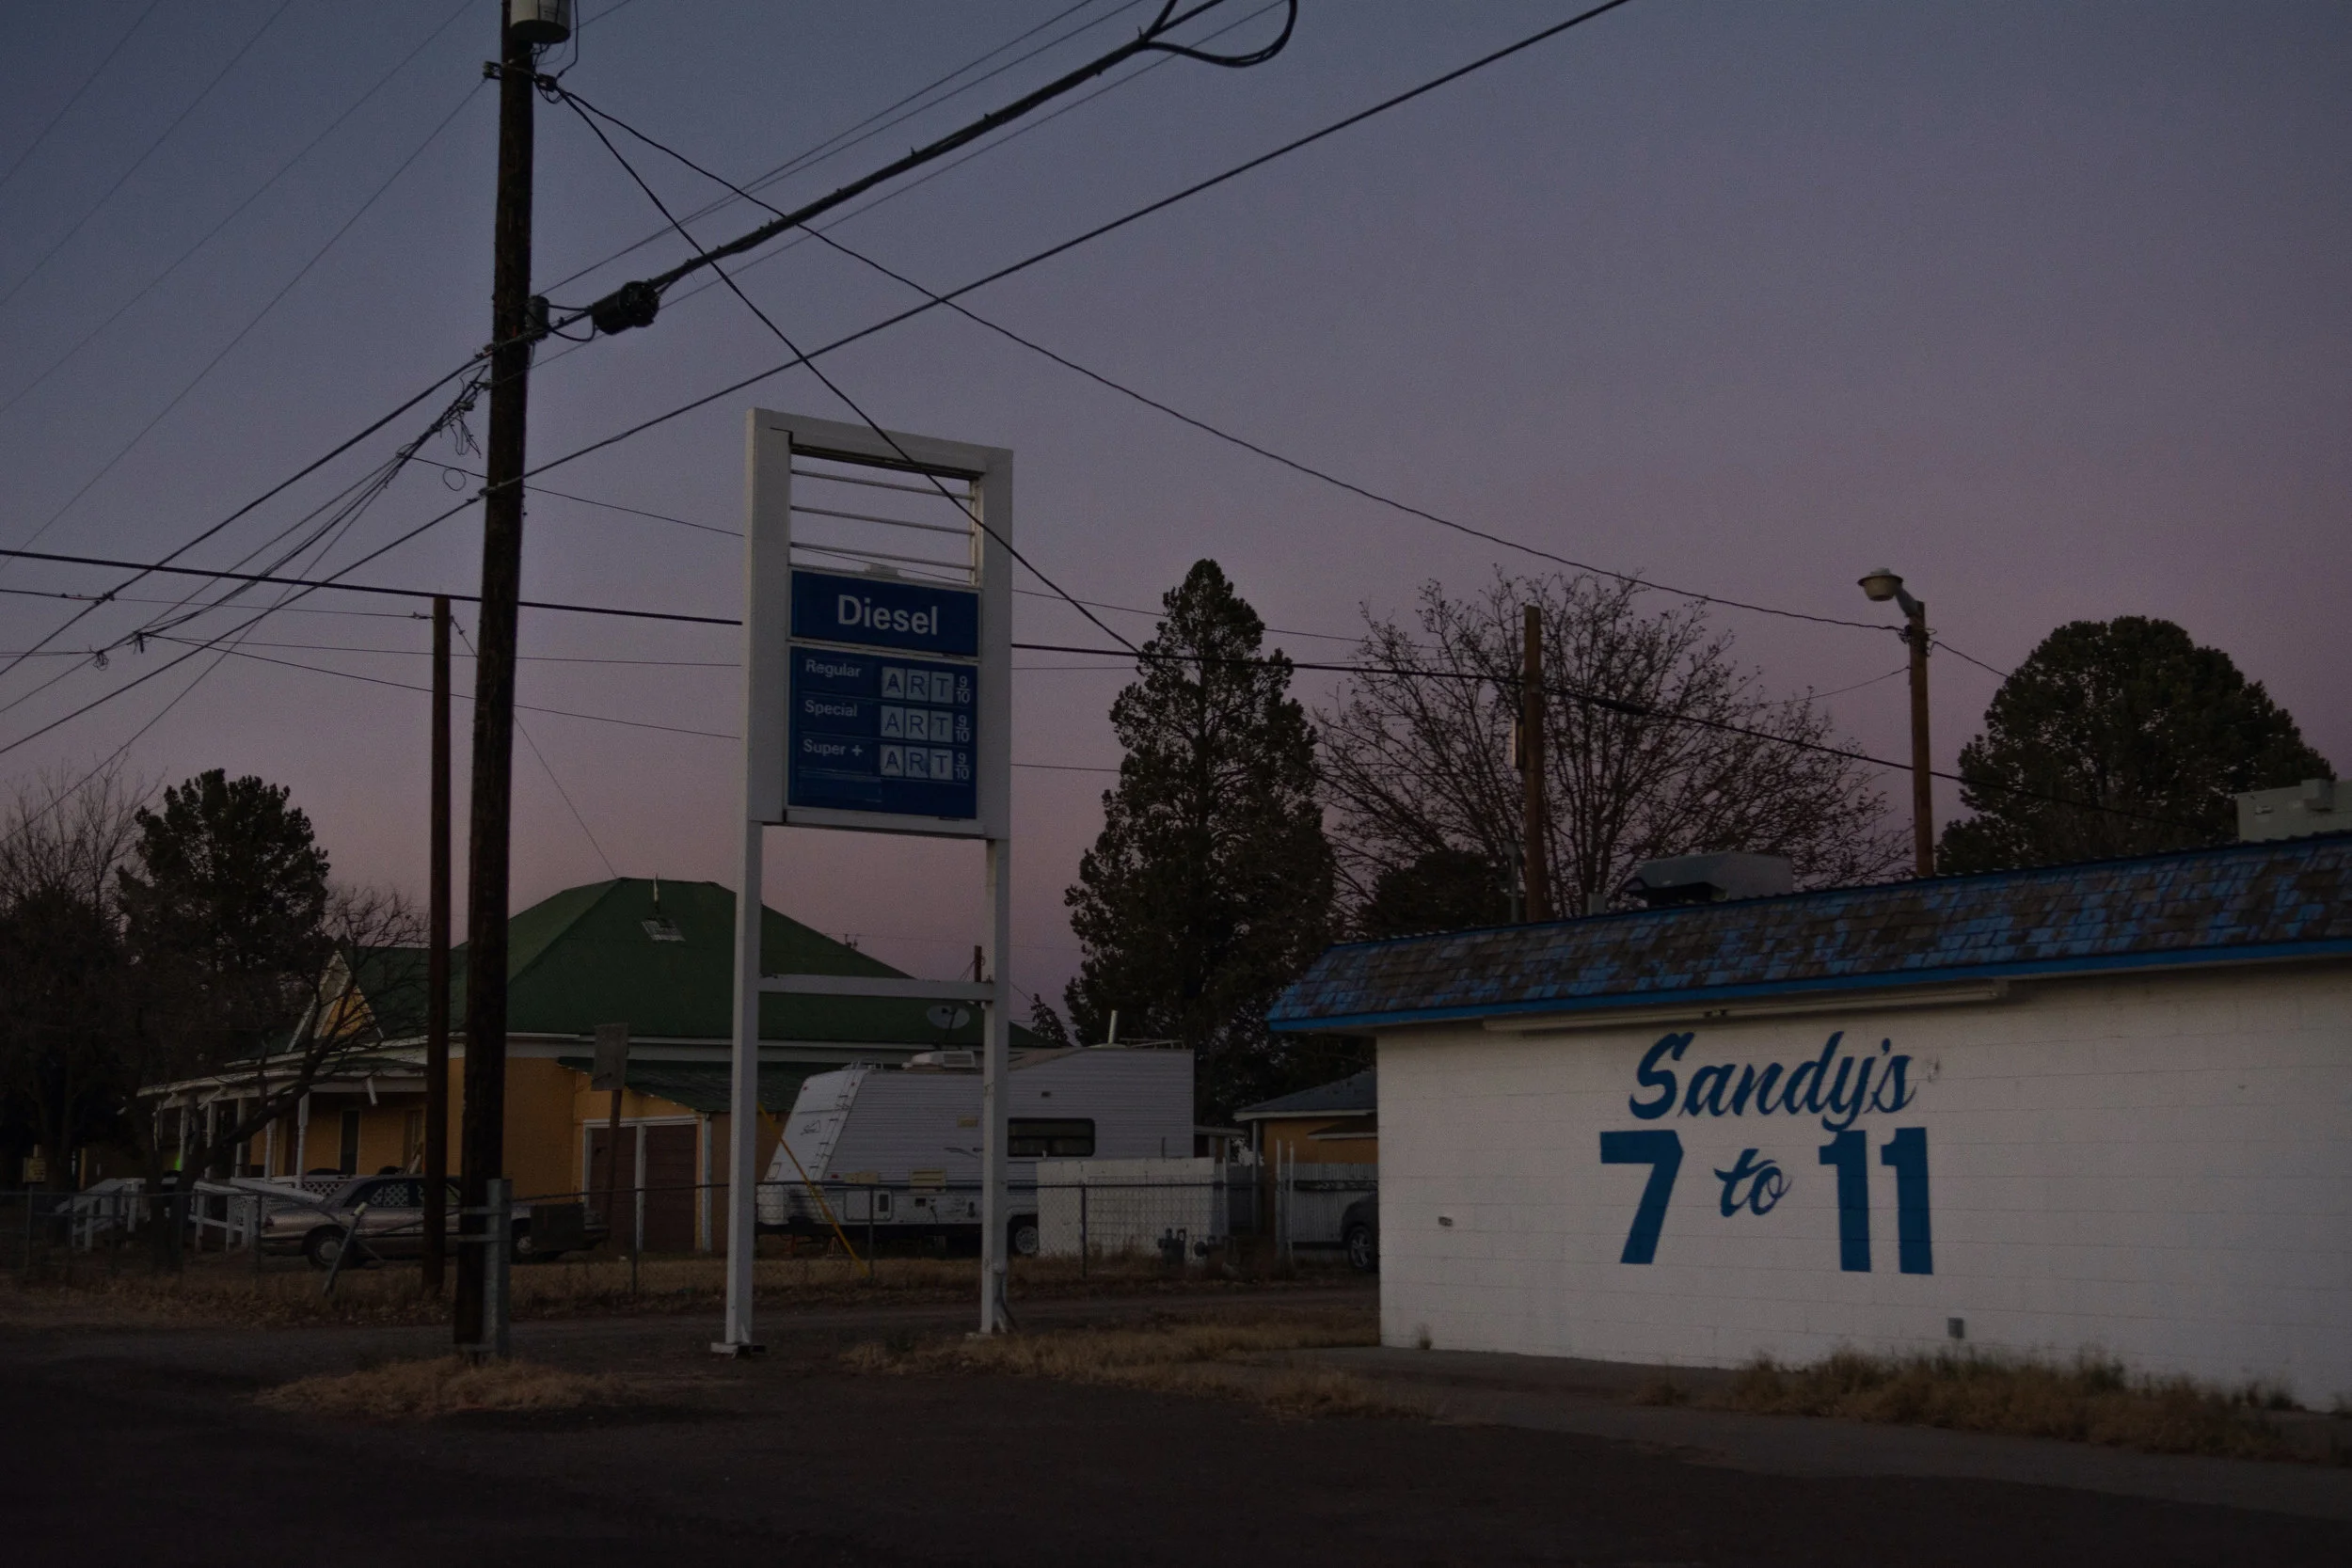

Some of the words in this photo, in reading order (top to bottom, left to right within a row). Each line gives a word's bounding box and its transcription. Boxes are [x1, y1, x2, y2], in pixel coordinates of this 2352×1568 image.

[836, 594, 939, 636] Diesel
[804, 658, 863, 678] Regular
[885, 672, 950, 698] ART
[803, 699, 859, 718] Special
[883, 712, 949, 736] ART
[803, 737, 847, 757] Super
[883, 750, 949, 773] ART
[1629, 1031, 1916, 1132] Sandy's
[1600, 1129, 1683, 1265] 7
[1714, 1148, 1791, 1218] to
[1819, 1127, 1933, 1275] 11
